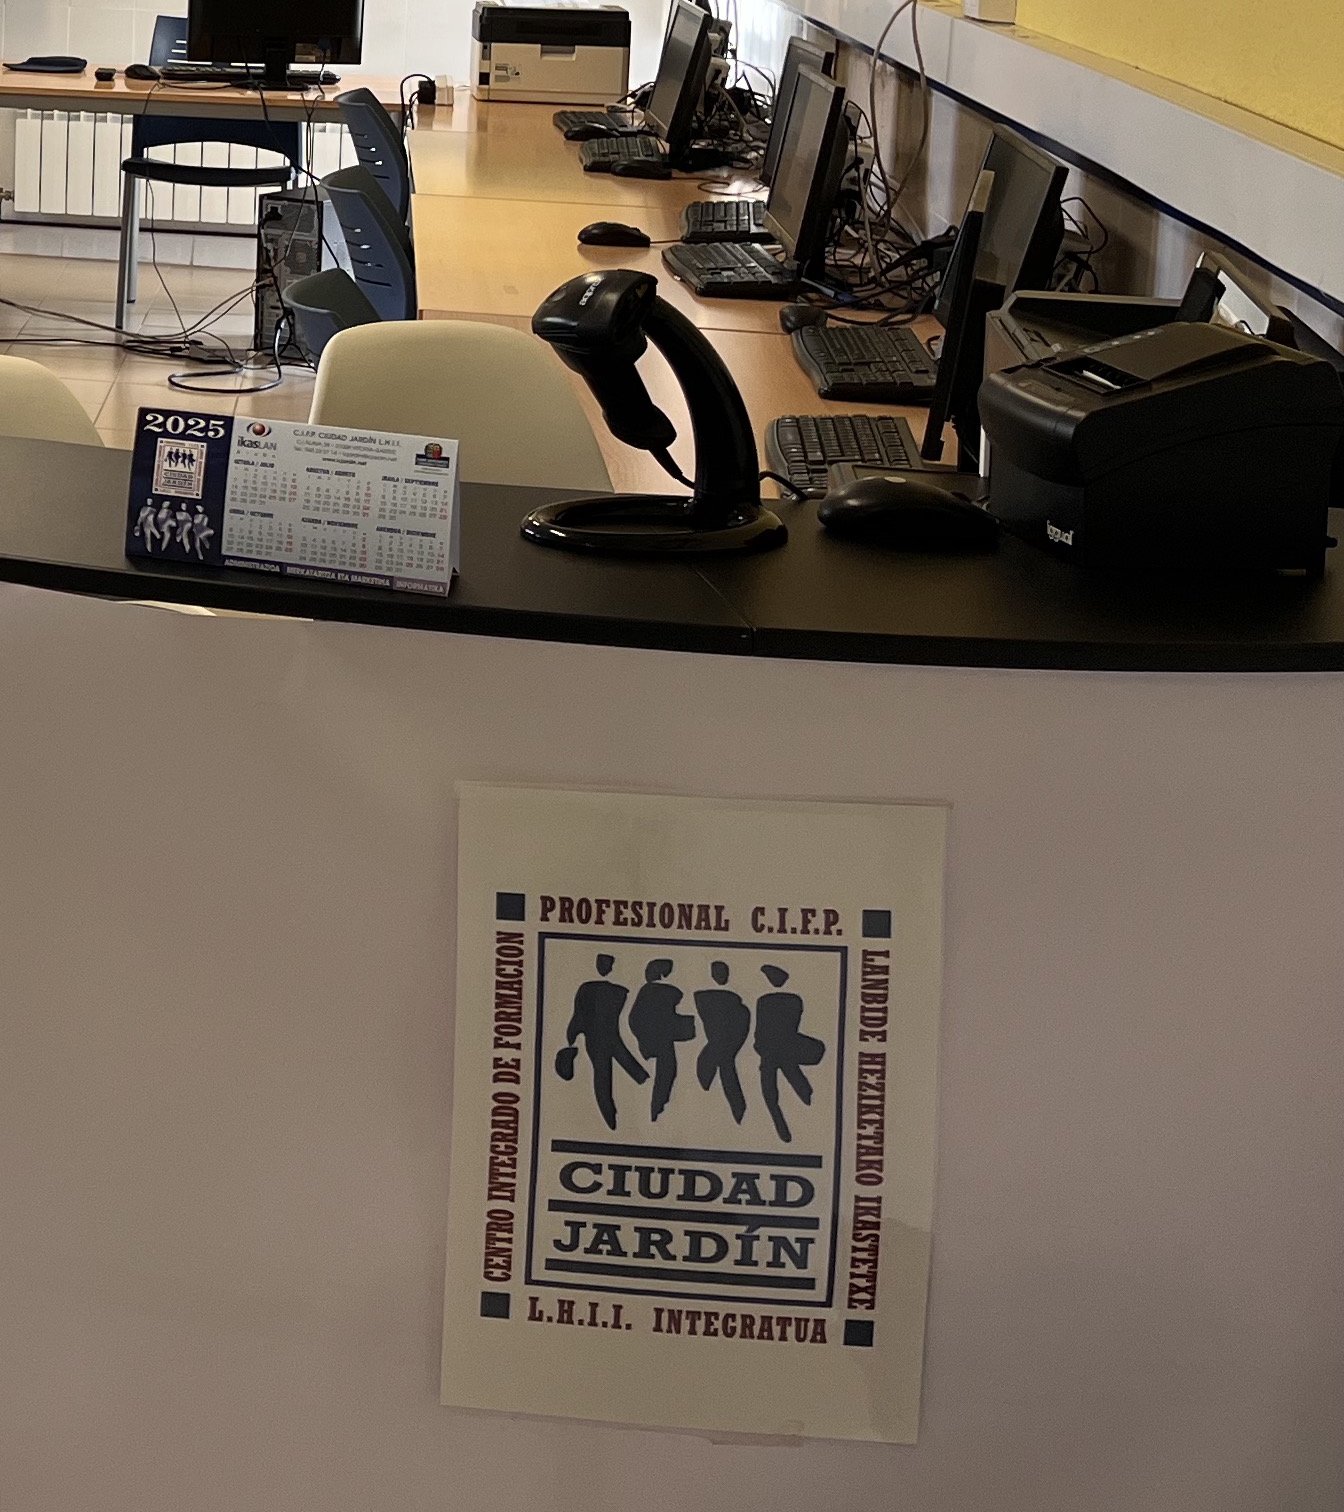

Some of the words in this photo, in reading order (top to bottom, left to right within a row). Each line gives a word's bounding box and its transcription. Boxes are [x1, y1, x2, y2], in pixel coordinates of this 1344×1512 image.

[144, 413, 226, 439] 2025
[1046, 519, 1075, 546] iggual
[539, 895, 730, 932] PROFESIONAL
[751, 906, 843, 937] C.I.F.P.
[493, 930, 525, 1051] FORMACION
[858, 948, 891, 1043] LANBIDE
[492, 1056, 522, 1085] DE
[487, 1091, 521, 1203] INTEGRADO
[854, 1051, 887, 1187] HEZIKETAKO
[558, 1160, 815, 1209] CIUDAD
[483, 1208, 515, 1283] CENTRO
[552, 1214, 816, 1270] JARDÍN
[846, 1194, 883, 1311] IKASTETXE
[527, 1296, 633, 1331] L.H.I.I.
[652, 1307, 828, 1345] INTEGRATUA
